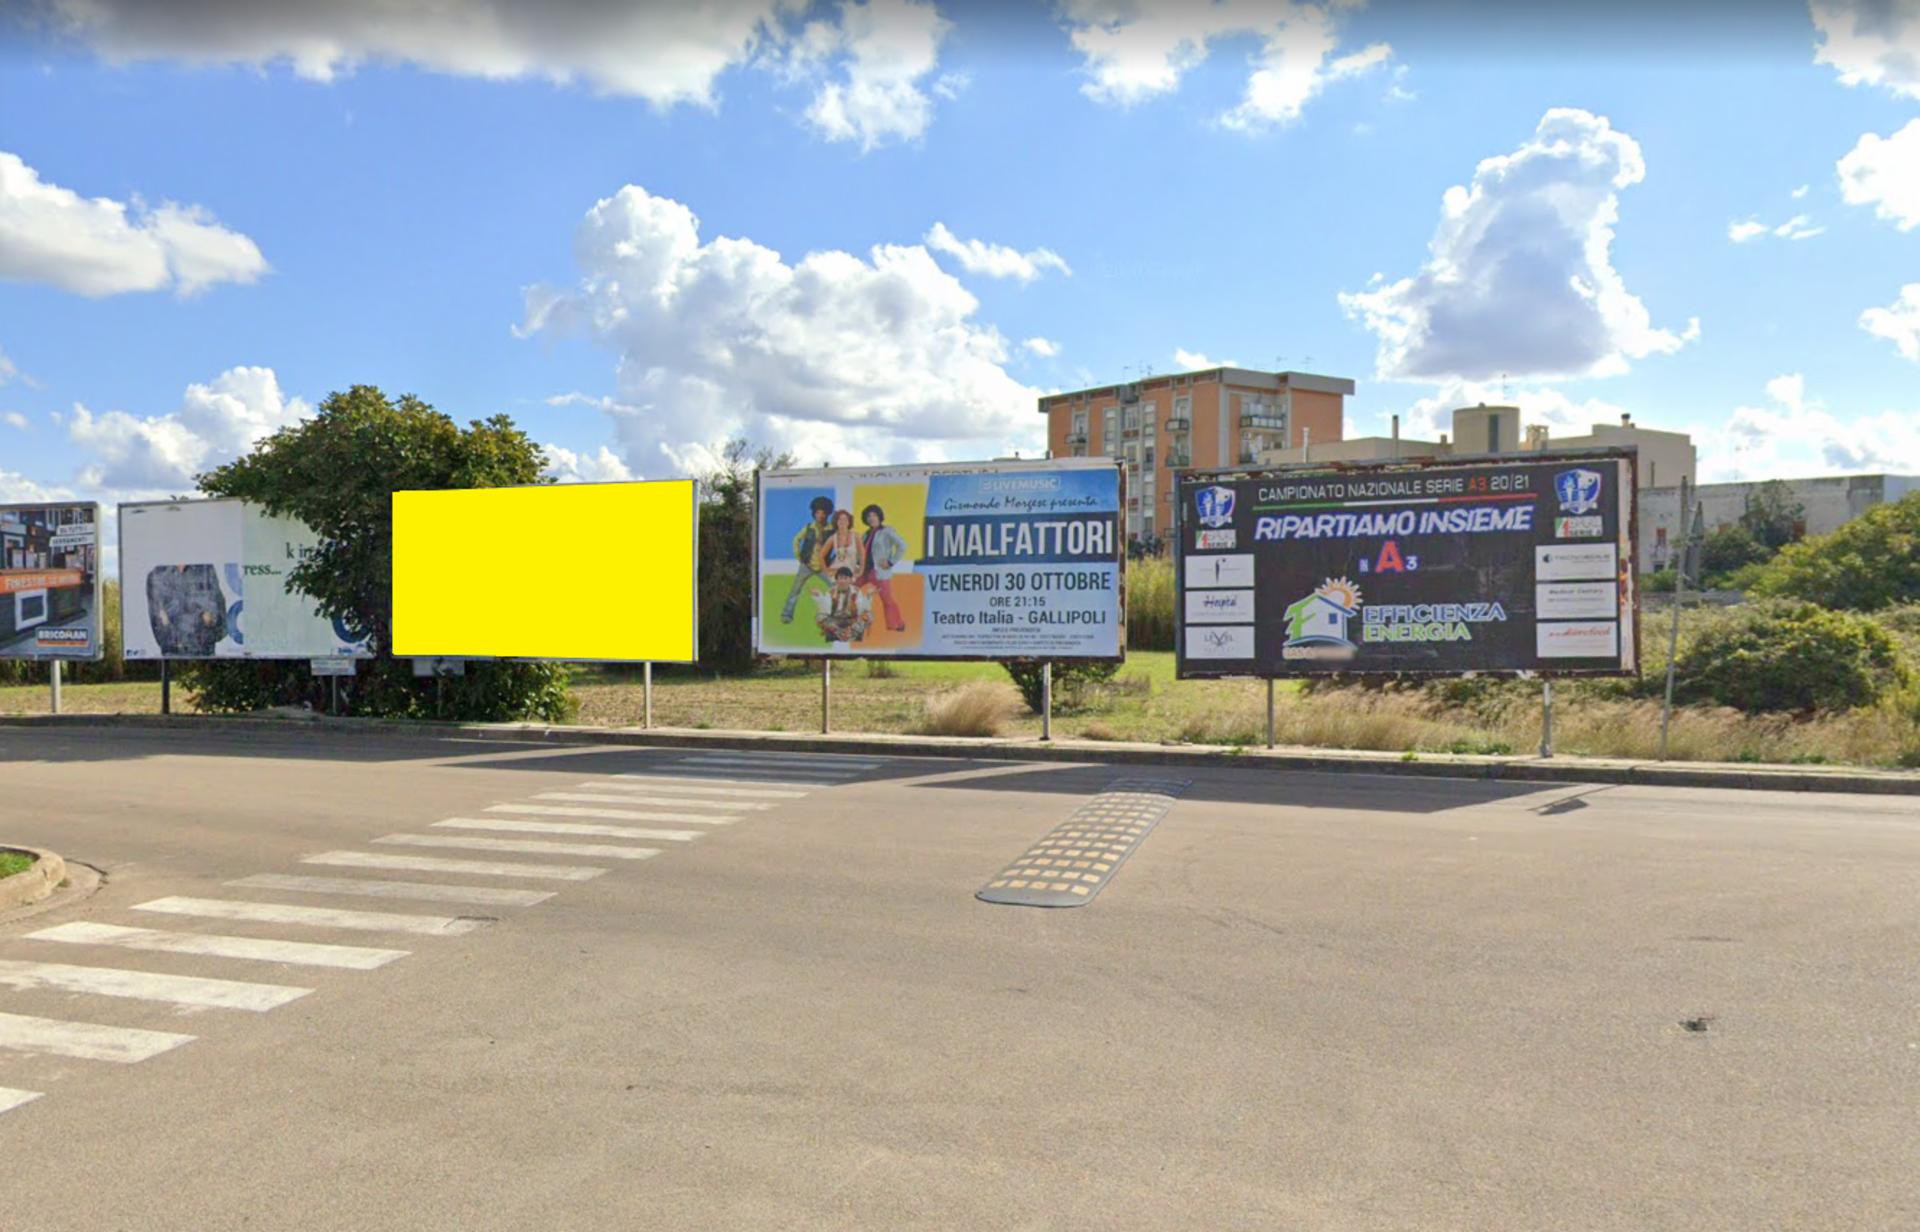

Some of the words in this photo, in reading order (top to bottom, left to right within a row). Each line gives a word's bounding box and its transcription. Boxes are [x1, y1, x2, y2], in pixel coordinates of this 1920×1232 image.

[1259, 485, 1345, 502] CAMPIONATO
[1348, 479, 1421, 497] NAZIONALE
[1425, 478, 1463, 494] SERIE
[1468, 476, 1487, 490] A3
[1490, 475, 1529, 491] 20/21
[1254, 511, 1415, 541] RIPARTIAMO
[1418, 505, 1534, 534] INSIEME
[928, 525, 934, 557] I
[943, 520, 1113, 557] MALFATTORI
[928, 573, 999, 592] VENERDI
[1005, 572, 1026, 591] 30
[1031, 571, 1111, 591] OTTOBRE
[989, 597, 1011, 607] ORE
[1014, 596, 1046, 607] 21:15
[932, 611, 975, 625] Teatro
[979, 611, 1014, 625] Italia
[1028, 610, 1106, 625] GALLIPOLI
[1363, 602, 1507, 624] EFFICIENZA
[38, 630, 87, 639] BRICOMAN
[1363, 622, 1473, 643] ENERGIA
